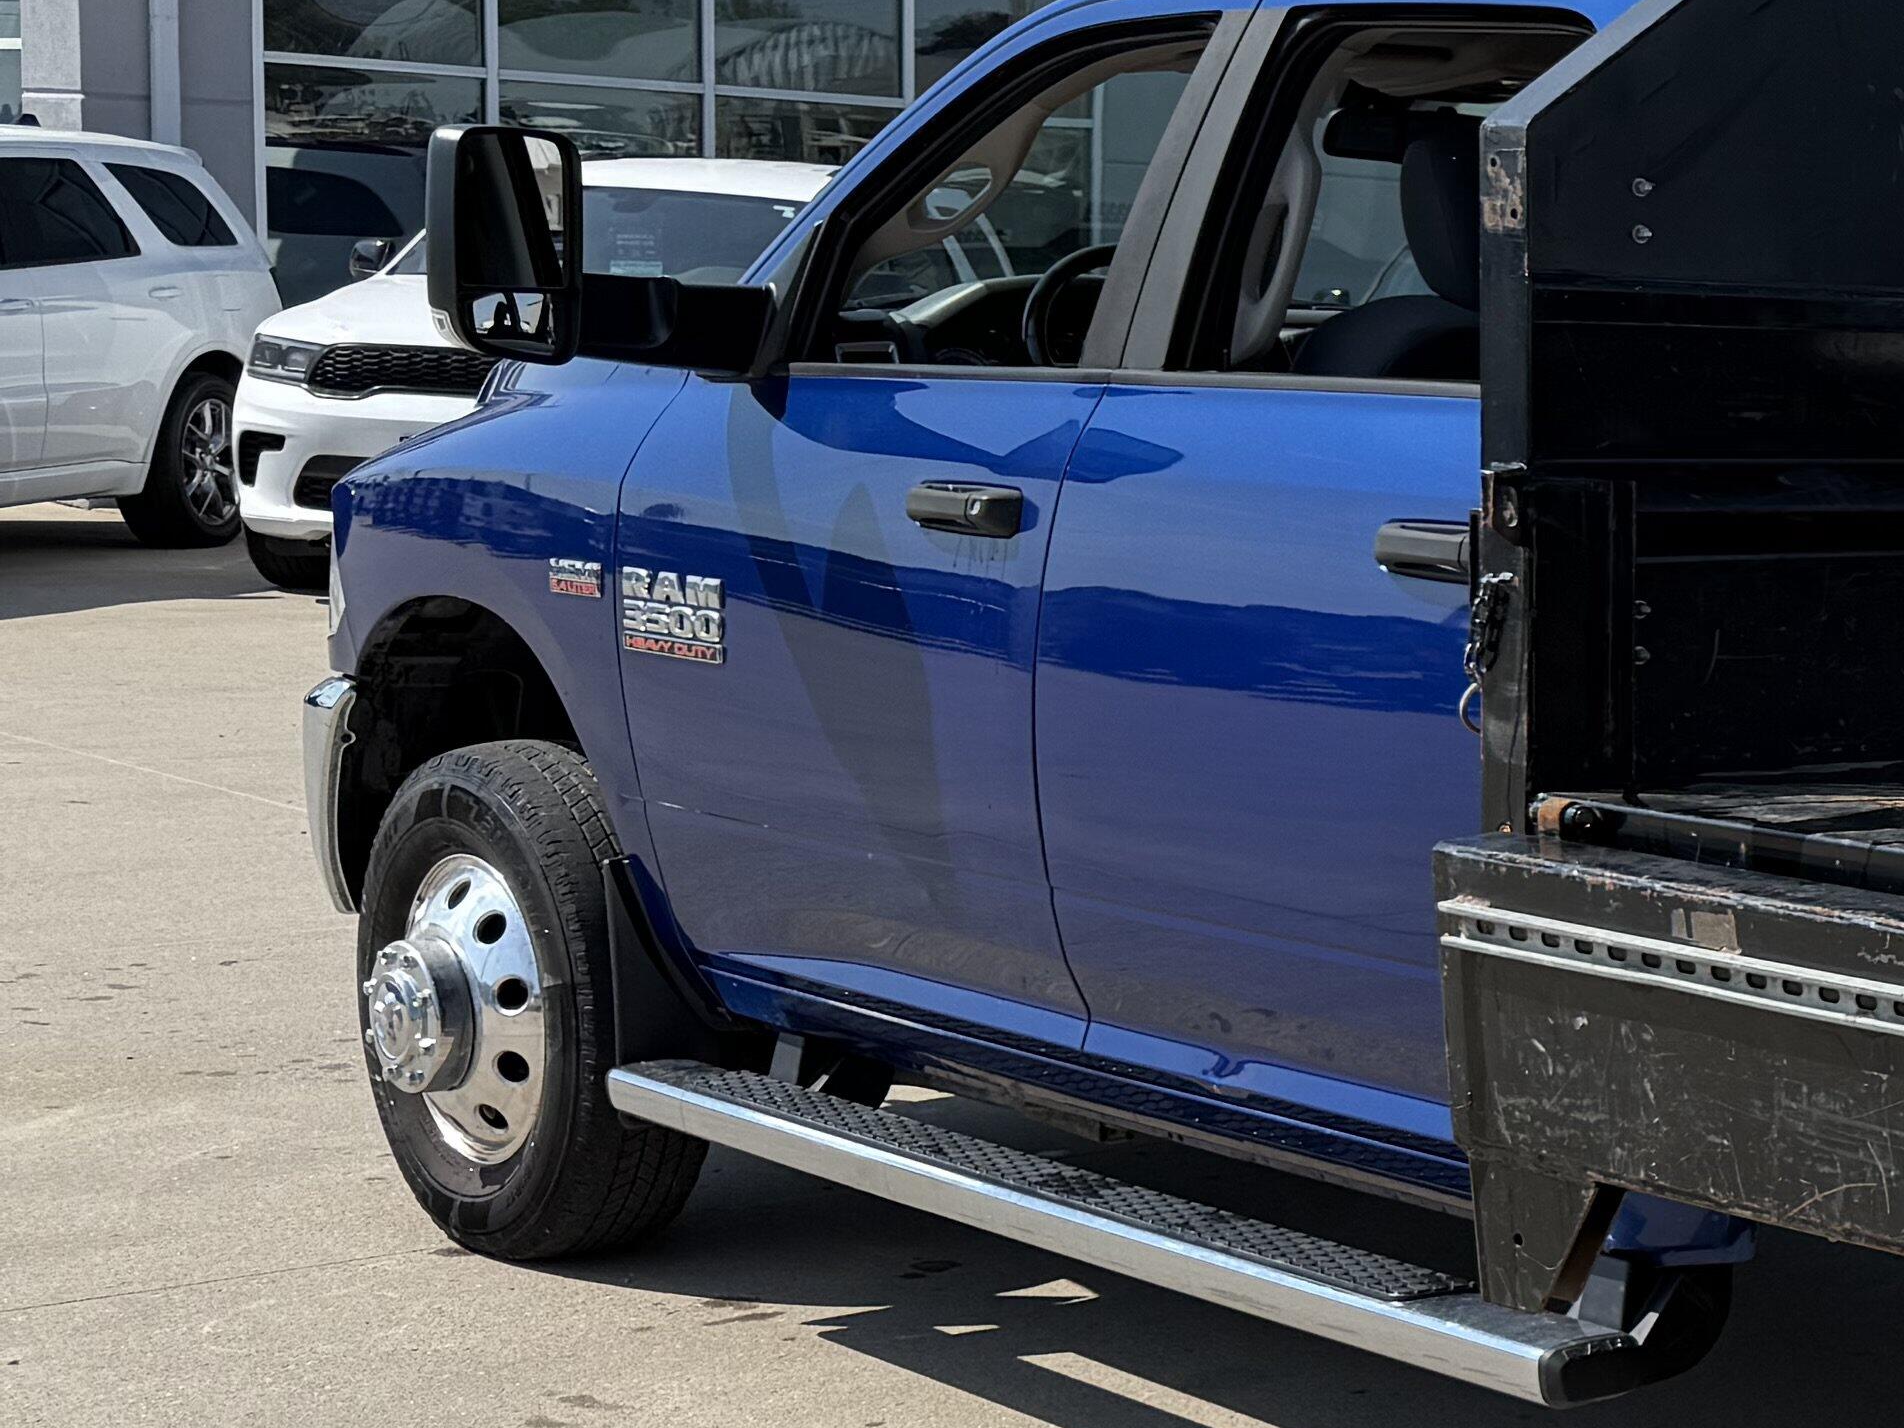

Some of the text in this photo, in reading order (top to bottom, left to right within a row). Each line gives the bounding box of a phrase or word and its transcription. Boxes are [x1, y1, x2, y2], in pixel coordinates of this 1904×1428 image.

[622, 566, 722, 609] RAM
[623, 599, 722, 642] 3500
[625, 634, 714, 660] HEAVY DUTY
